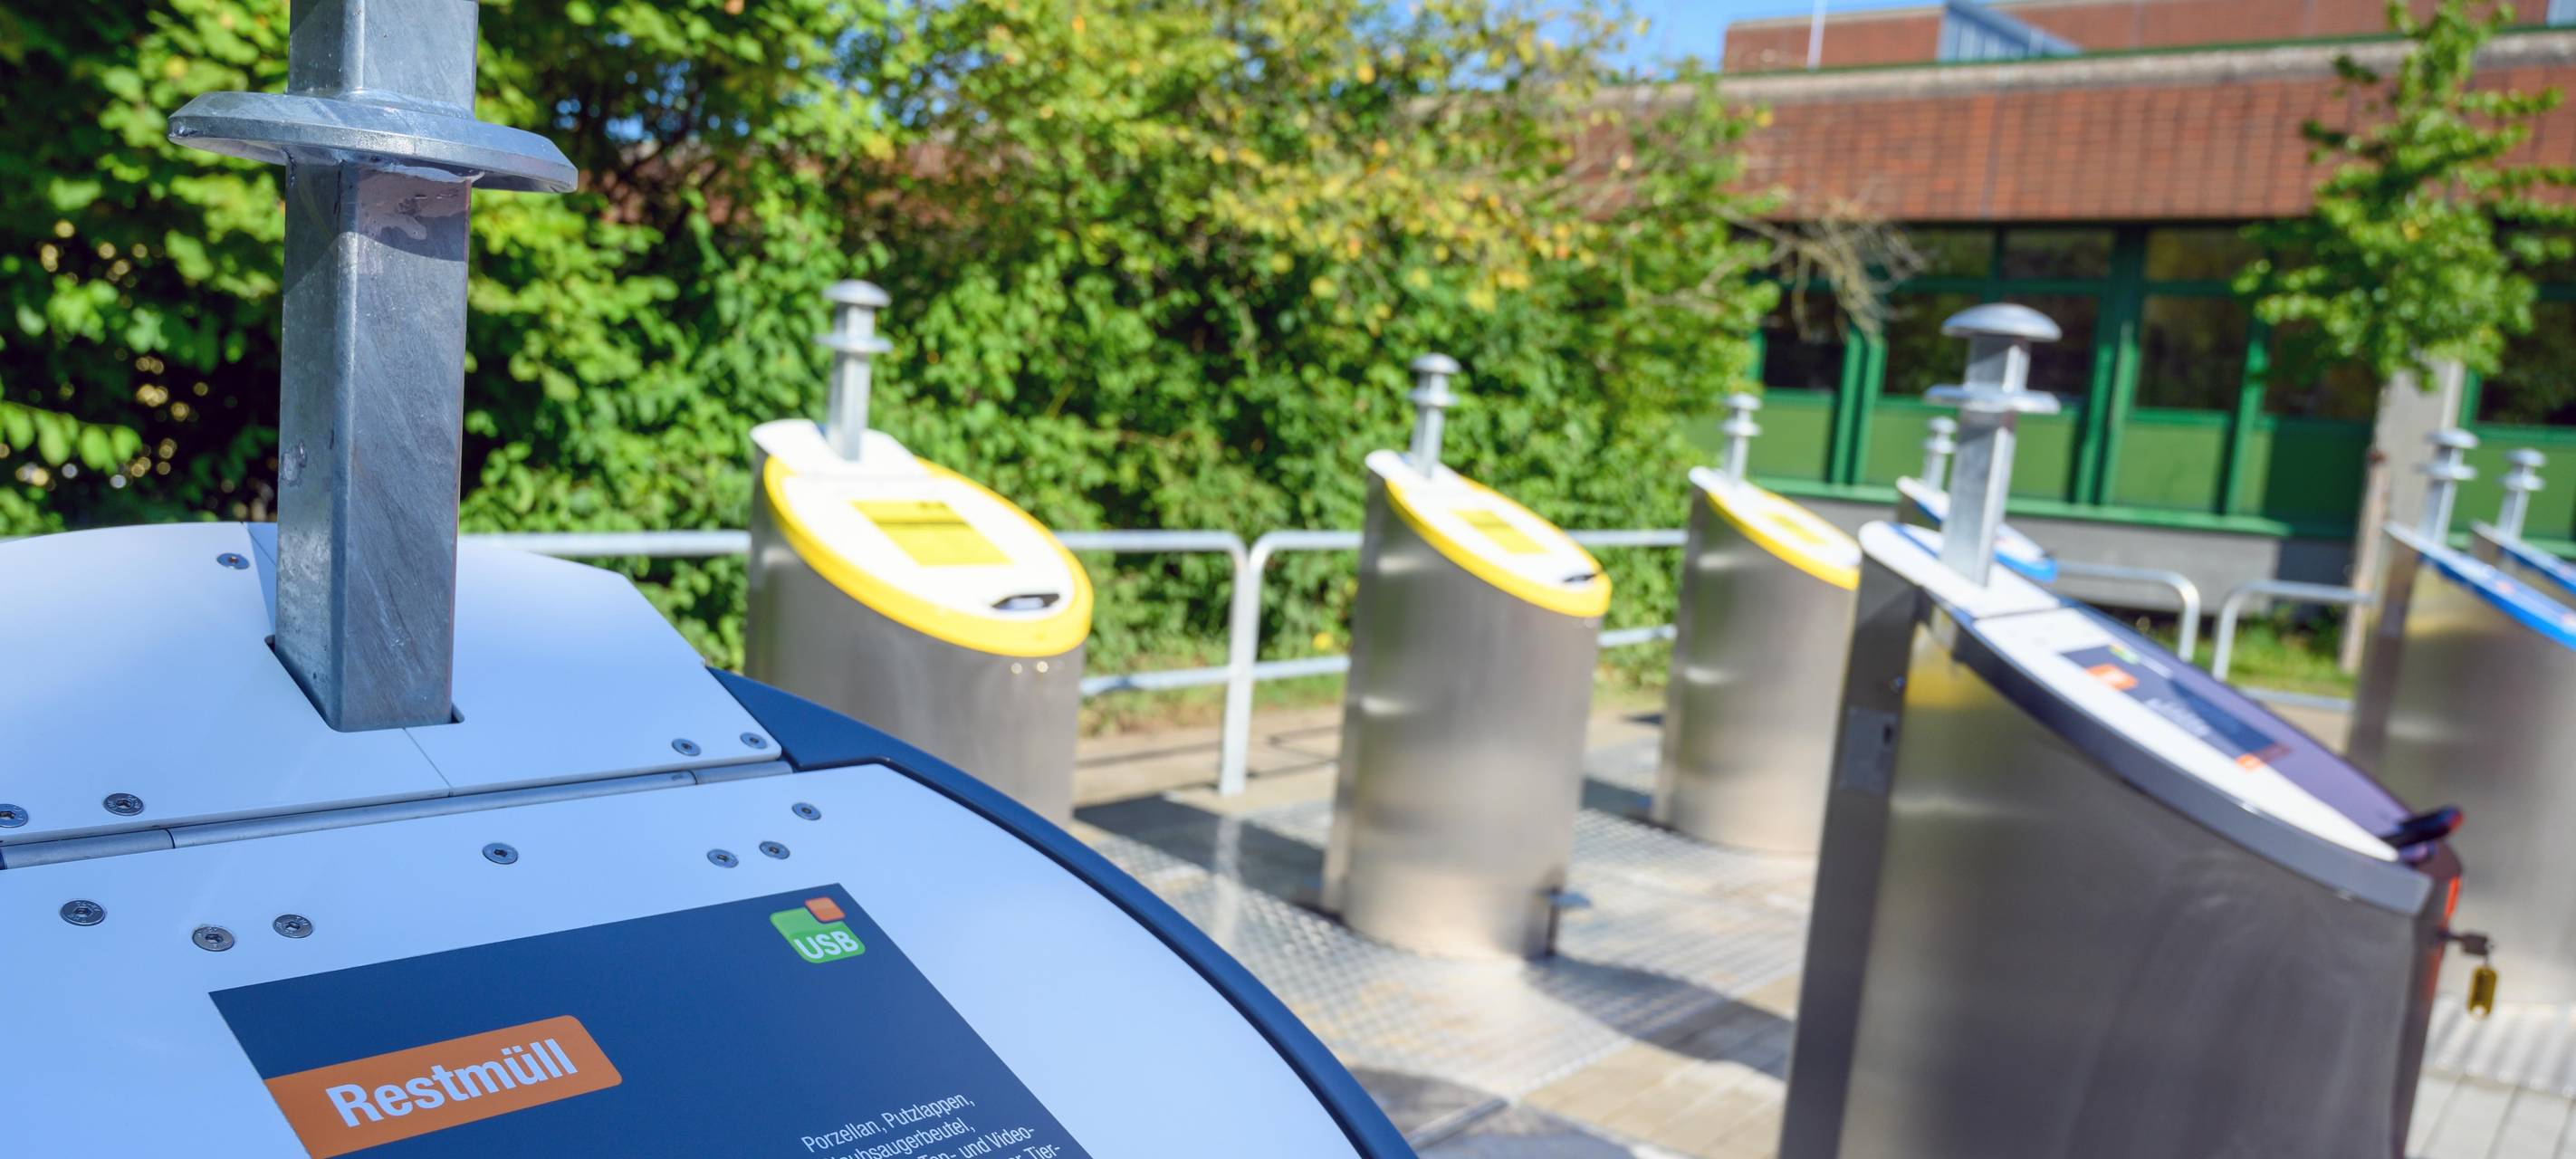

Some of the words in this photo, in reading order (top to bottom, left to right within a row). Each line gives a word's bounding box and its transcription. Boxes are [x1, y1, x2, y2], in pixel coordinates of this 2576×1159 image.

[793, 931, 858, 959] USB
[325, 1039, 579, 1128] Restmüll
[801, 1123, 887, 1153] Porzellan,
[881, 1094, 975, 1128] Putzlappen,
[823, 1117, 975, 1159] bsaugerbeutel,
[958, 1137, 991, 1158] und
[984, 1127, 1034, 1148] Video-
[1023, 1145, 1060, 1159] Tier-
